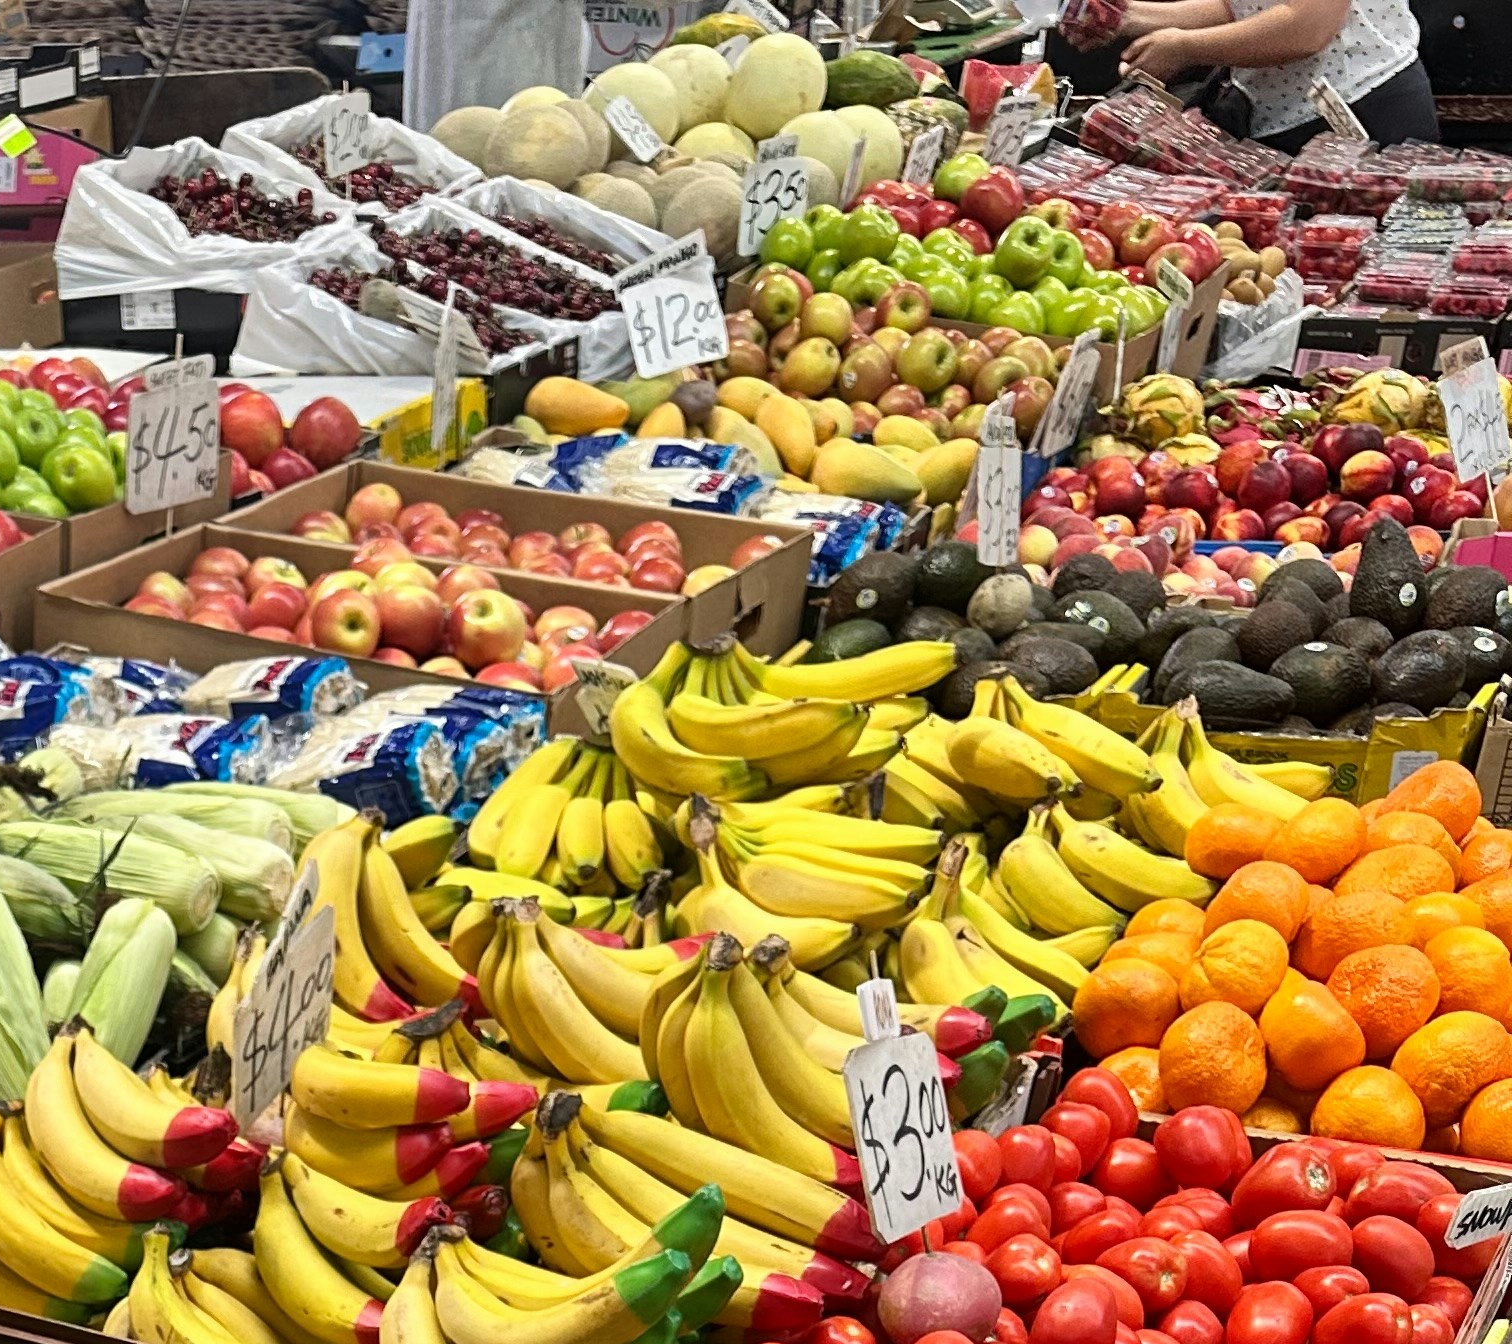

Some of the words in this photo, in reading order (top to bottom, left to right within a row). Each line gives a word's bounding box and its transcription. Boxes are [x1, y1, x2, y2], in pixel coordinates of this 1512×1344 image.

[633, 293, 719, 365] $12.00
[132, 402, 217, 499] $4.50
[242, 951, 333, 1113] $4.00
[859, 1064, 945, 1229] $3.00
[934, 1162, 959, 1204] KG
